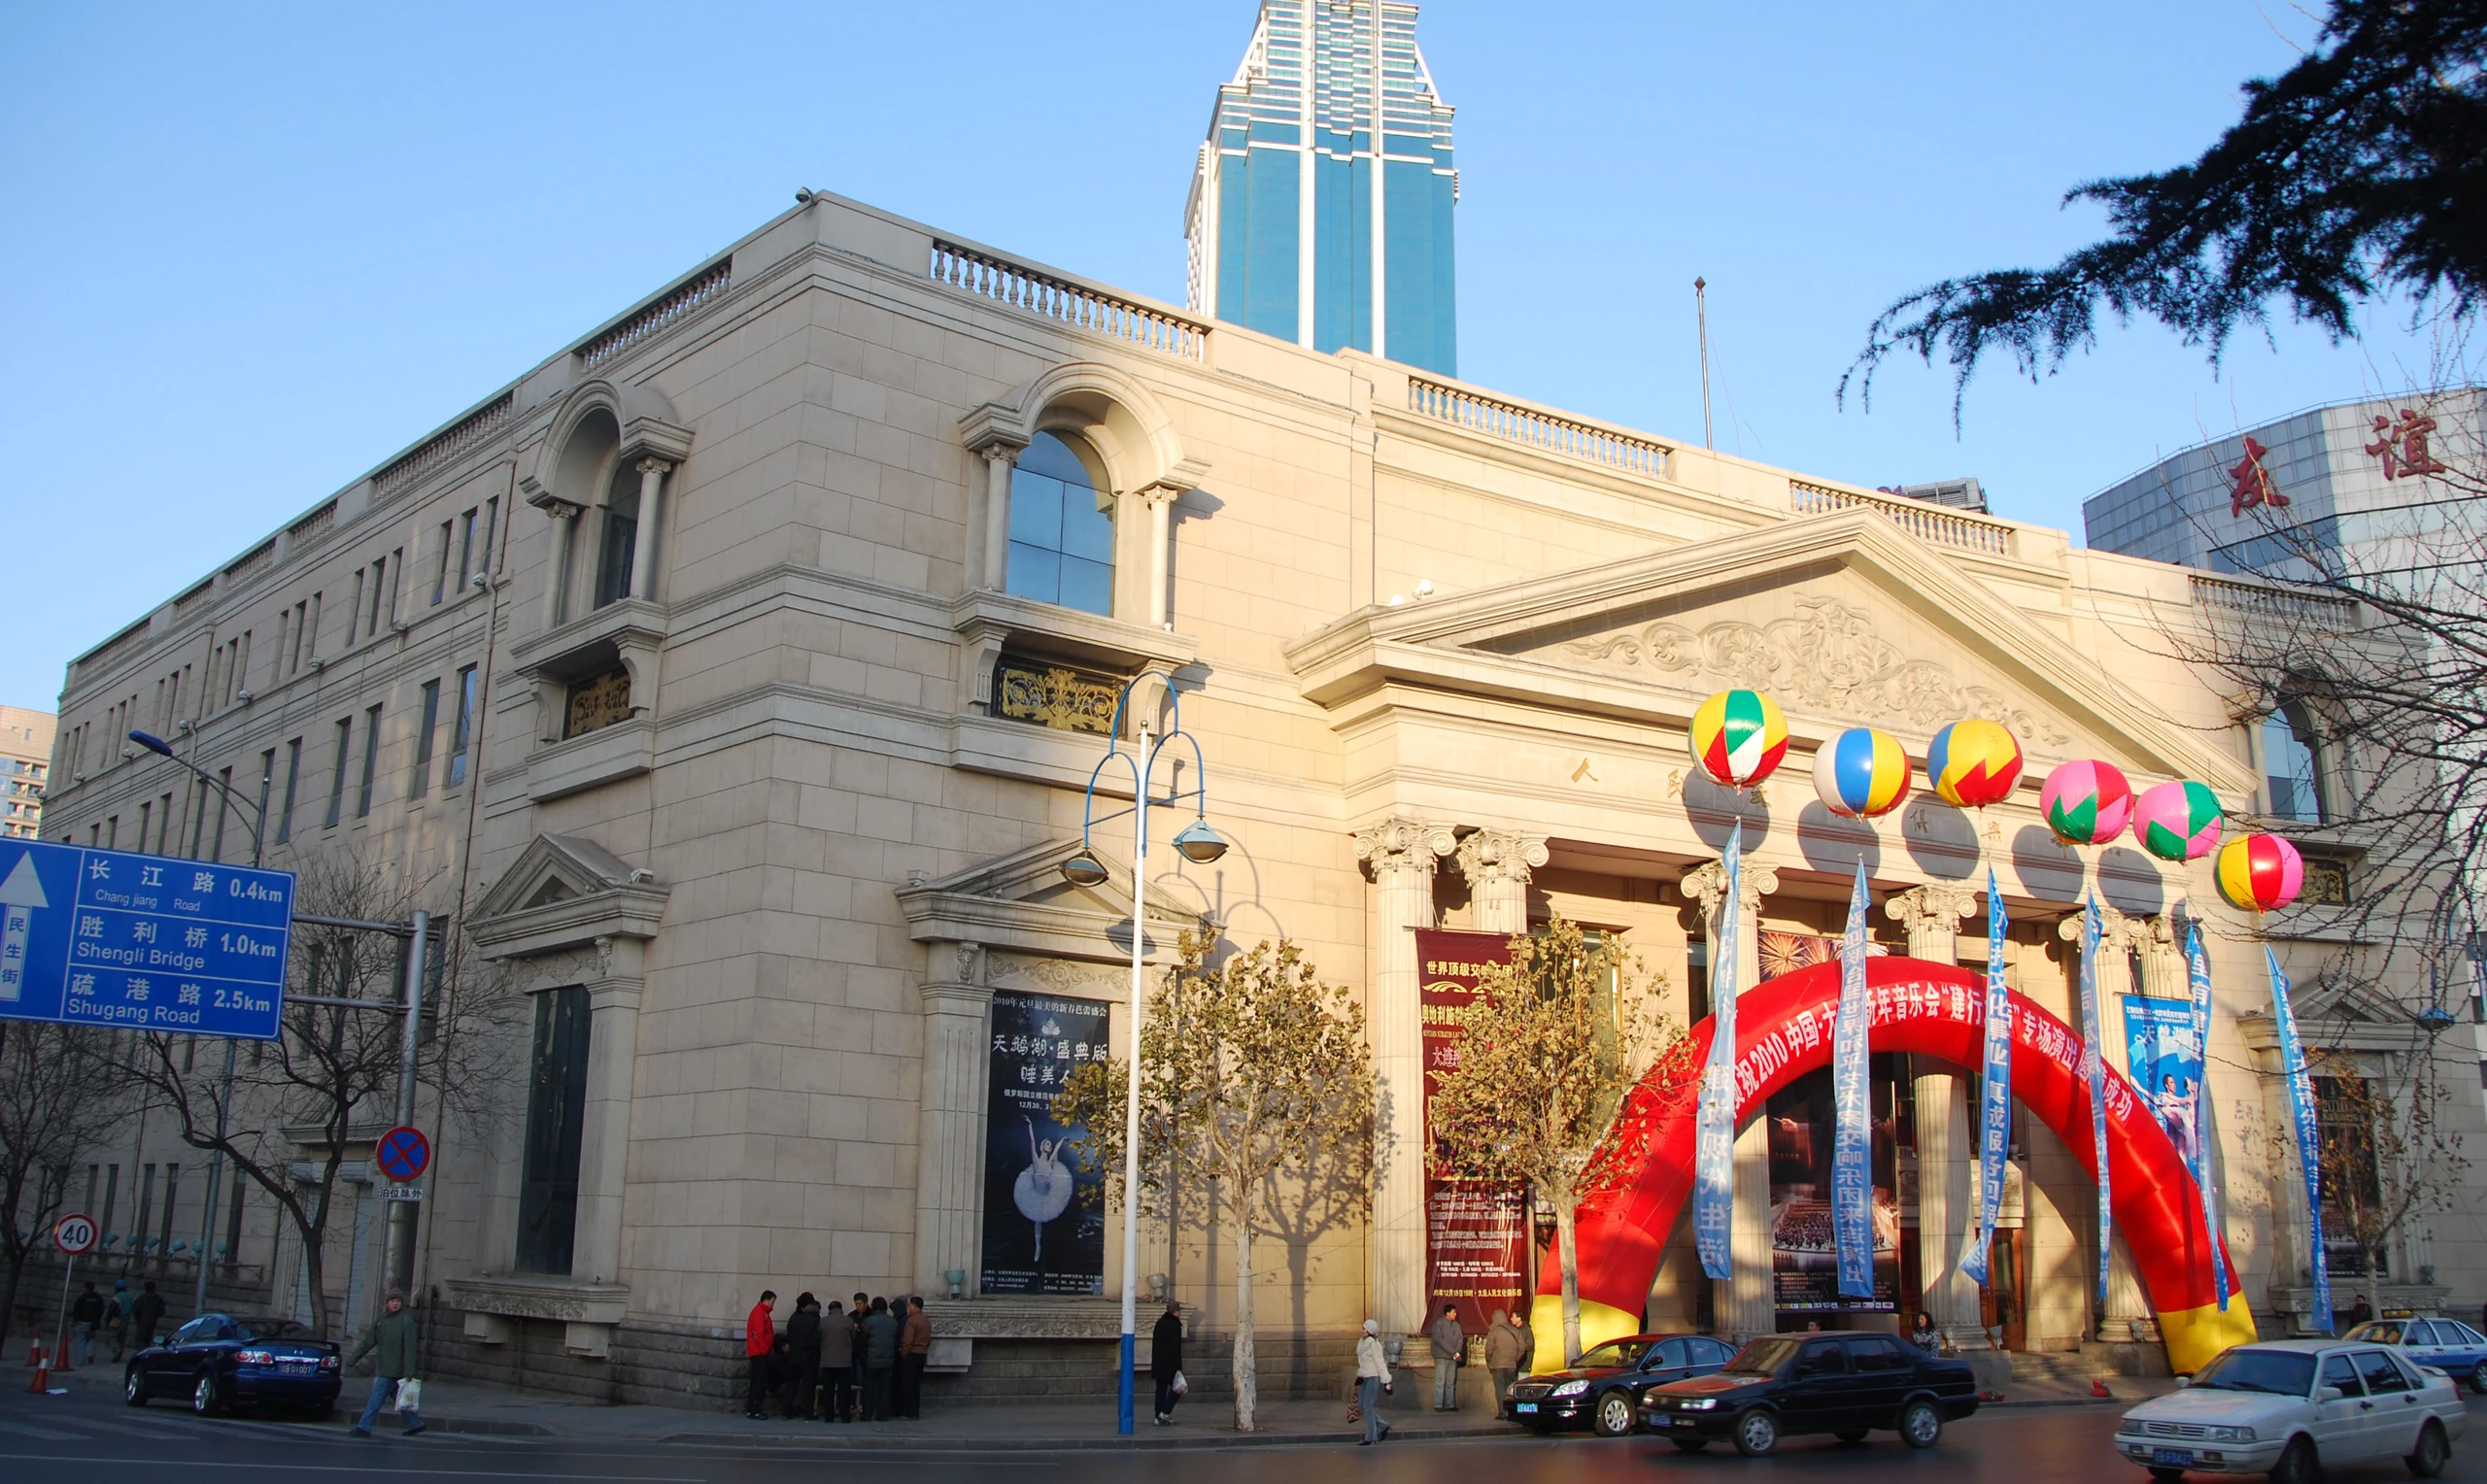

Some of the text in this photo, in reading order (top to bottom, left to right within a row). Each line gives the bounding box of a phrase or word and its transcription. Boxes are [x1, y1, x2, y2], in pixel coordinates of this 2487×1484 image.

[88, 859, 283, 903] 长江路 0.4km
[95, 889, 200, 912] Chang jiang Road
[2, 917, 25, 985] 民生街
[79, 916, 277, 958] 胜利桥 1.0km
[77, 942, 205, 970] Shengli Bridge
[71, 973, 270, 1012] 疏港路 2.5km
[68, 998, 200, 1025] Shugang Road
[379, 1187, 423, 1198] 泊位除外
[62, 1224, 89, 1245] 40
